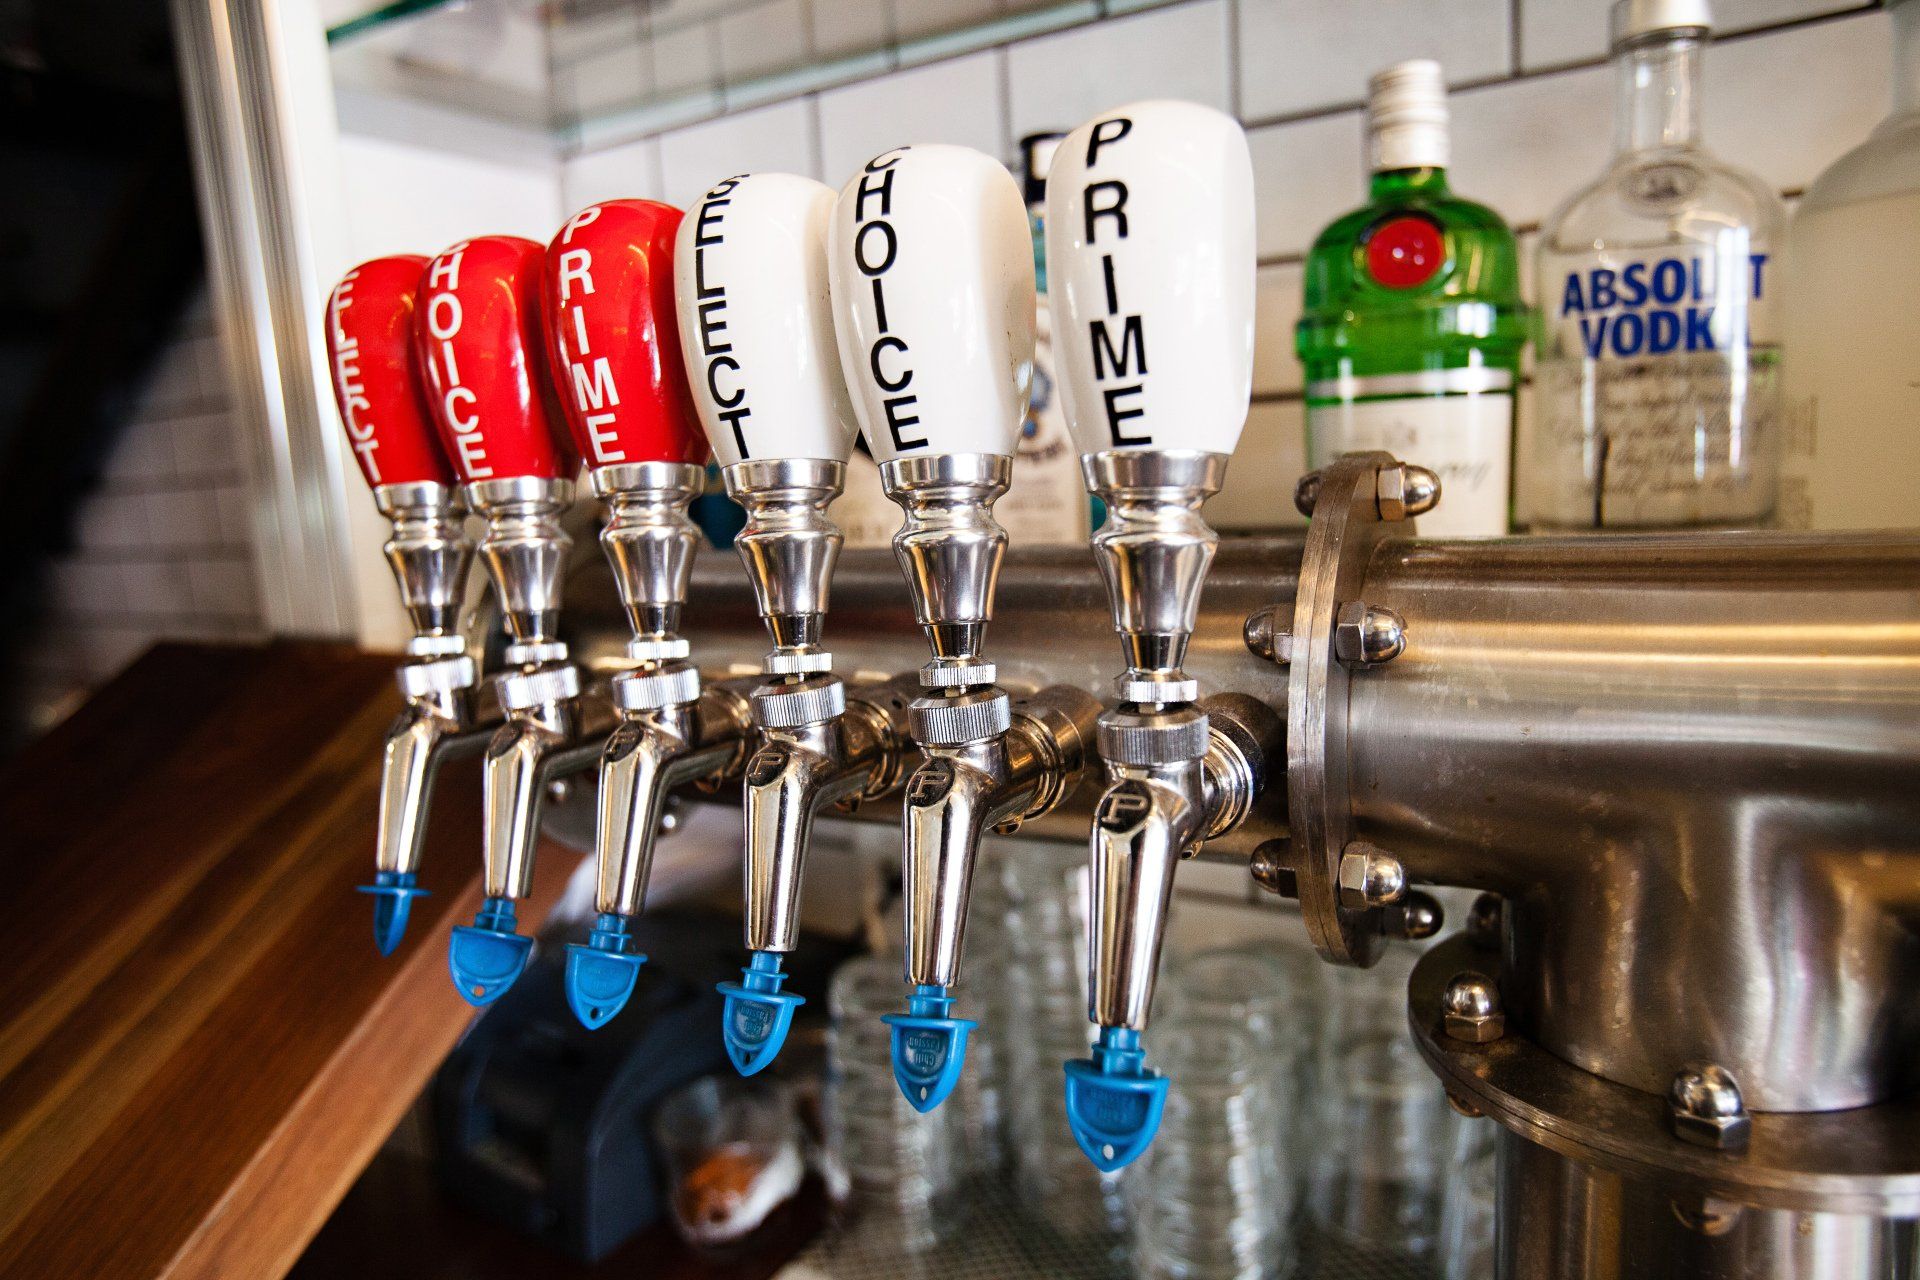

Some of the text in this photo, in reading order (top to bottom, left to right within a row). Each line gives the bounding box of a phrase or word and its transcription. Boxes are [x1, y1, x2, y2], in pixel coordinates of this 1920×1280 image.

[332, 271, 382, 483] ELECT
[560, 206, 625, 464] PRIME
[695, 174, 751, 459] SELECT
[855, 146, 929, 452] CHOICE
[1084, 118, 1152, 446] PRIME
[1563, 254, 1769, 318] ABSOLT
[1580, 307, 1751, 361] VODK
[910, 770, 949, 798] P
[1101, 793, 1148, 823] P
